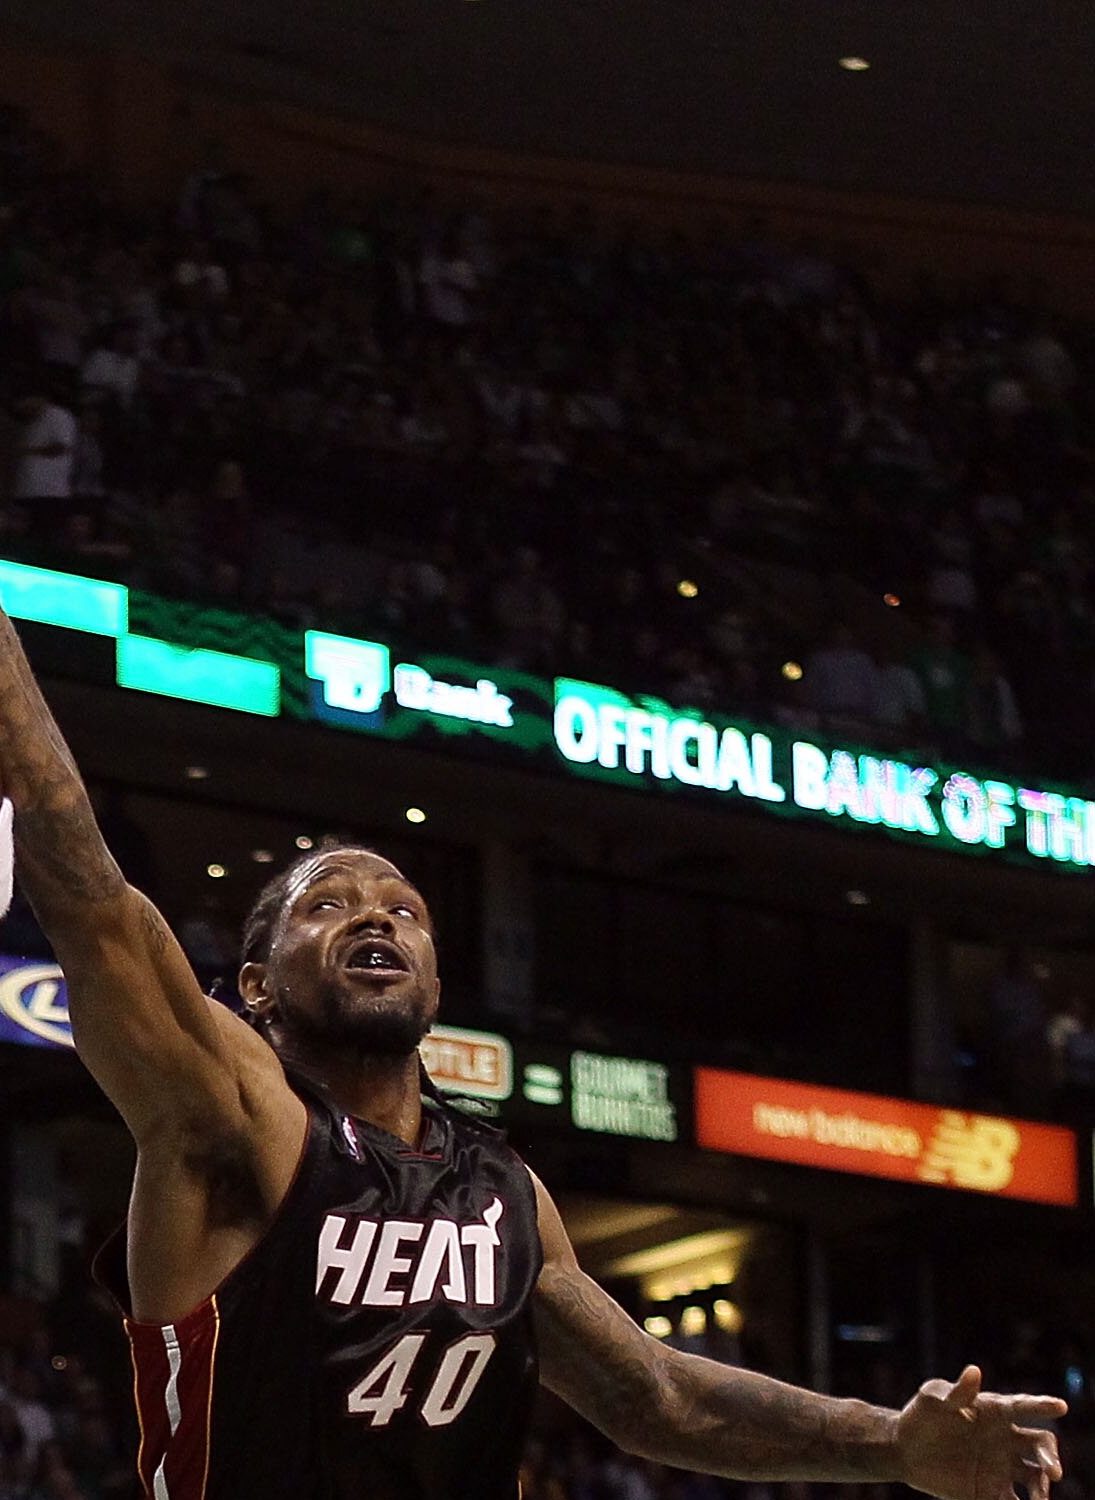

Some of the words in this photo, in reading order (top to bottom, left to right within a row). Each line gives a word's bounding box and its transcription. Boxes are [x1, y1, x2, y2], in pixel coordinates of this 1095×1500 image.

[394, 663, 513, 727] Bank
[554, 696, 785, 802] OFFICIAL
[793, 741, 940, 835] BANK
[941, 773, 1016, 848] OF
[315, 1197, 504, 1306] HEAT
[347, 1333, 497, 1427] 40
